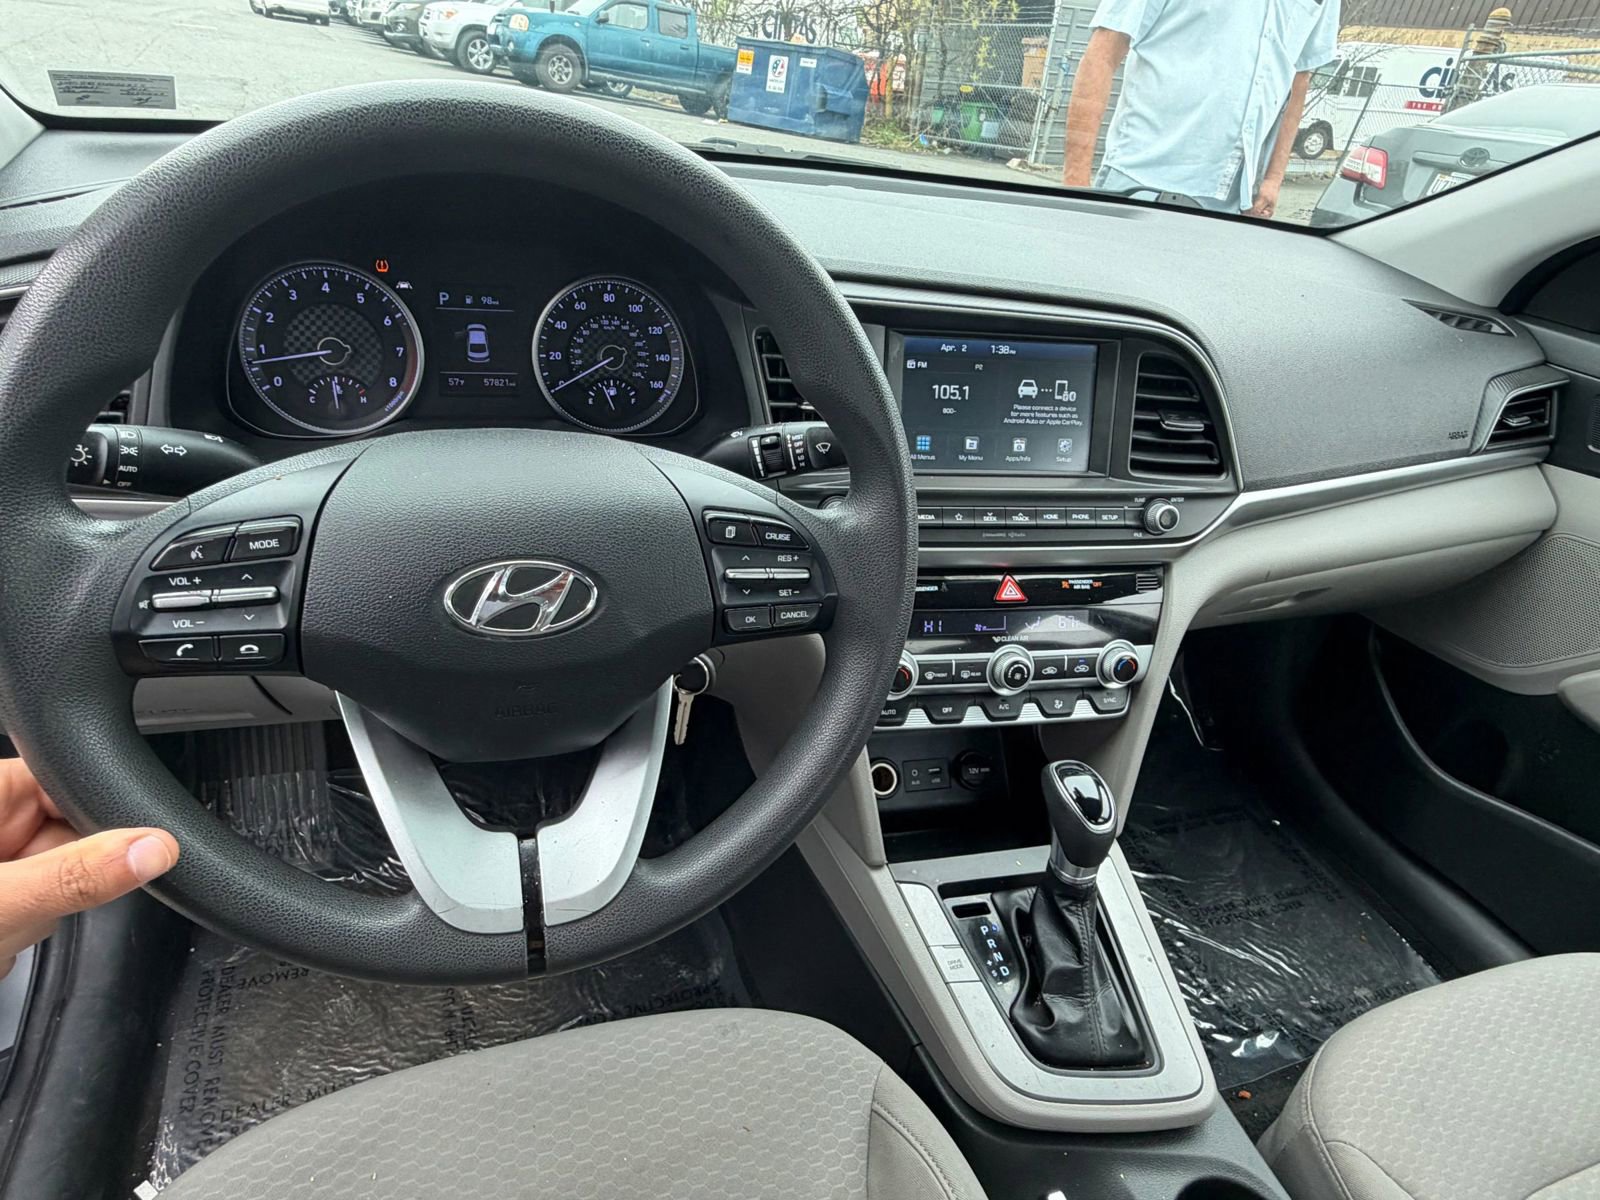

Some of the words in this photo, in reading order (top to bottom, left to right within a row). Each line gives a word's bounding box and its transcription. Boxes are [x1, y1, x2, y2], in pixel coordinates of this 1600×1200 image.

[321, 282, 330, 293] 4
[289, 290, 297, 300] 3
[356, 293, 365, 304] 5
[439, 292, 449, 304] P
[603, 293, 615, 302] 80
[574, 302, 587, 310] 60
[628, 304, 643, 312] 100
[266, 313, 274, 323] 2
[384, 316, 392, 326] 6
[554, 321, 567, 330] 40
[648, 327, 662, 335] 120
[260, 345, 266, 354] 1
[396, 347, 404, 357] 7
[941, 344, 956, 352] Apr.
[274, 377, 282, 386] 0
[389, 377, 397, 387] 8
[932, 385, 969, 400] 105.1
[765, 532, 791, 541] CRUISE
[249, 539, 280, 550] MODE
[780, 611, 809, 619] CANCEL
[980, 925, 989, 935] P
[987, 939, 997, 948] R
[993, 952, 1003, 962] N
[1000, 966, 1010, 976] D
[238, 967, 309, 990] REMOVE
[214, 966, 237, 1016] DEALER
[188, 969, 216, 1053] PROTECTIVE
[207, 1026, 226, 1067] MUST
[179, 1060, 202, 1114] COVER
[220, 1093, 291, 1122] DEALER
